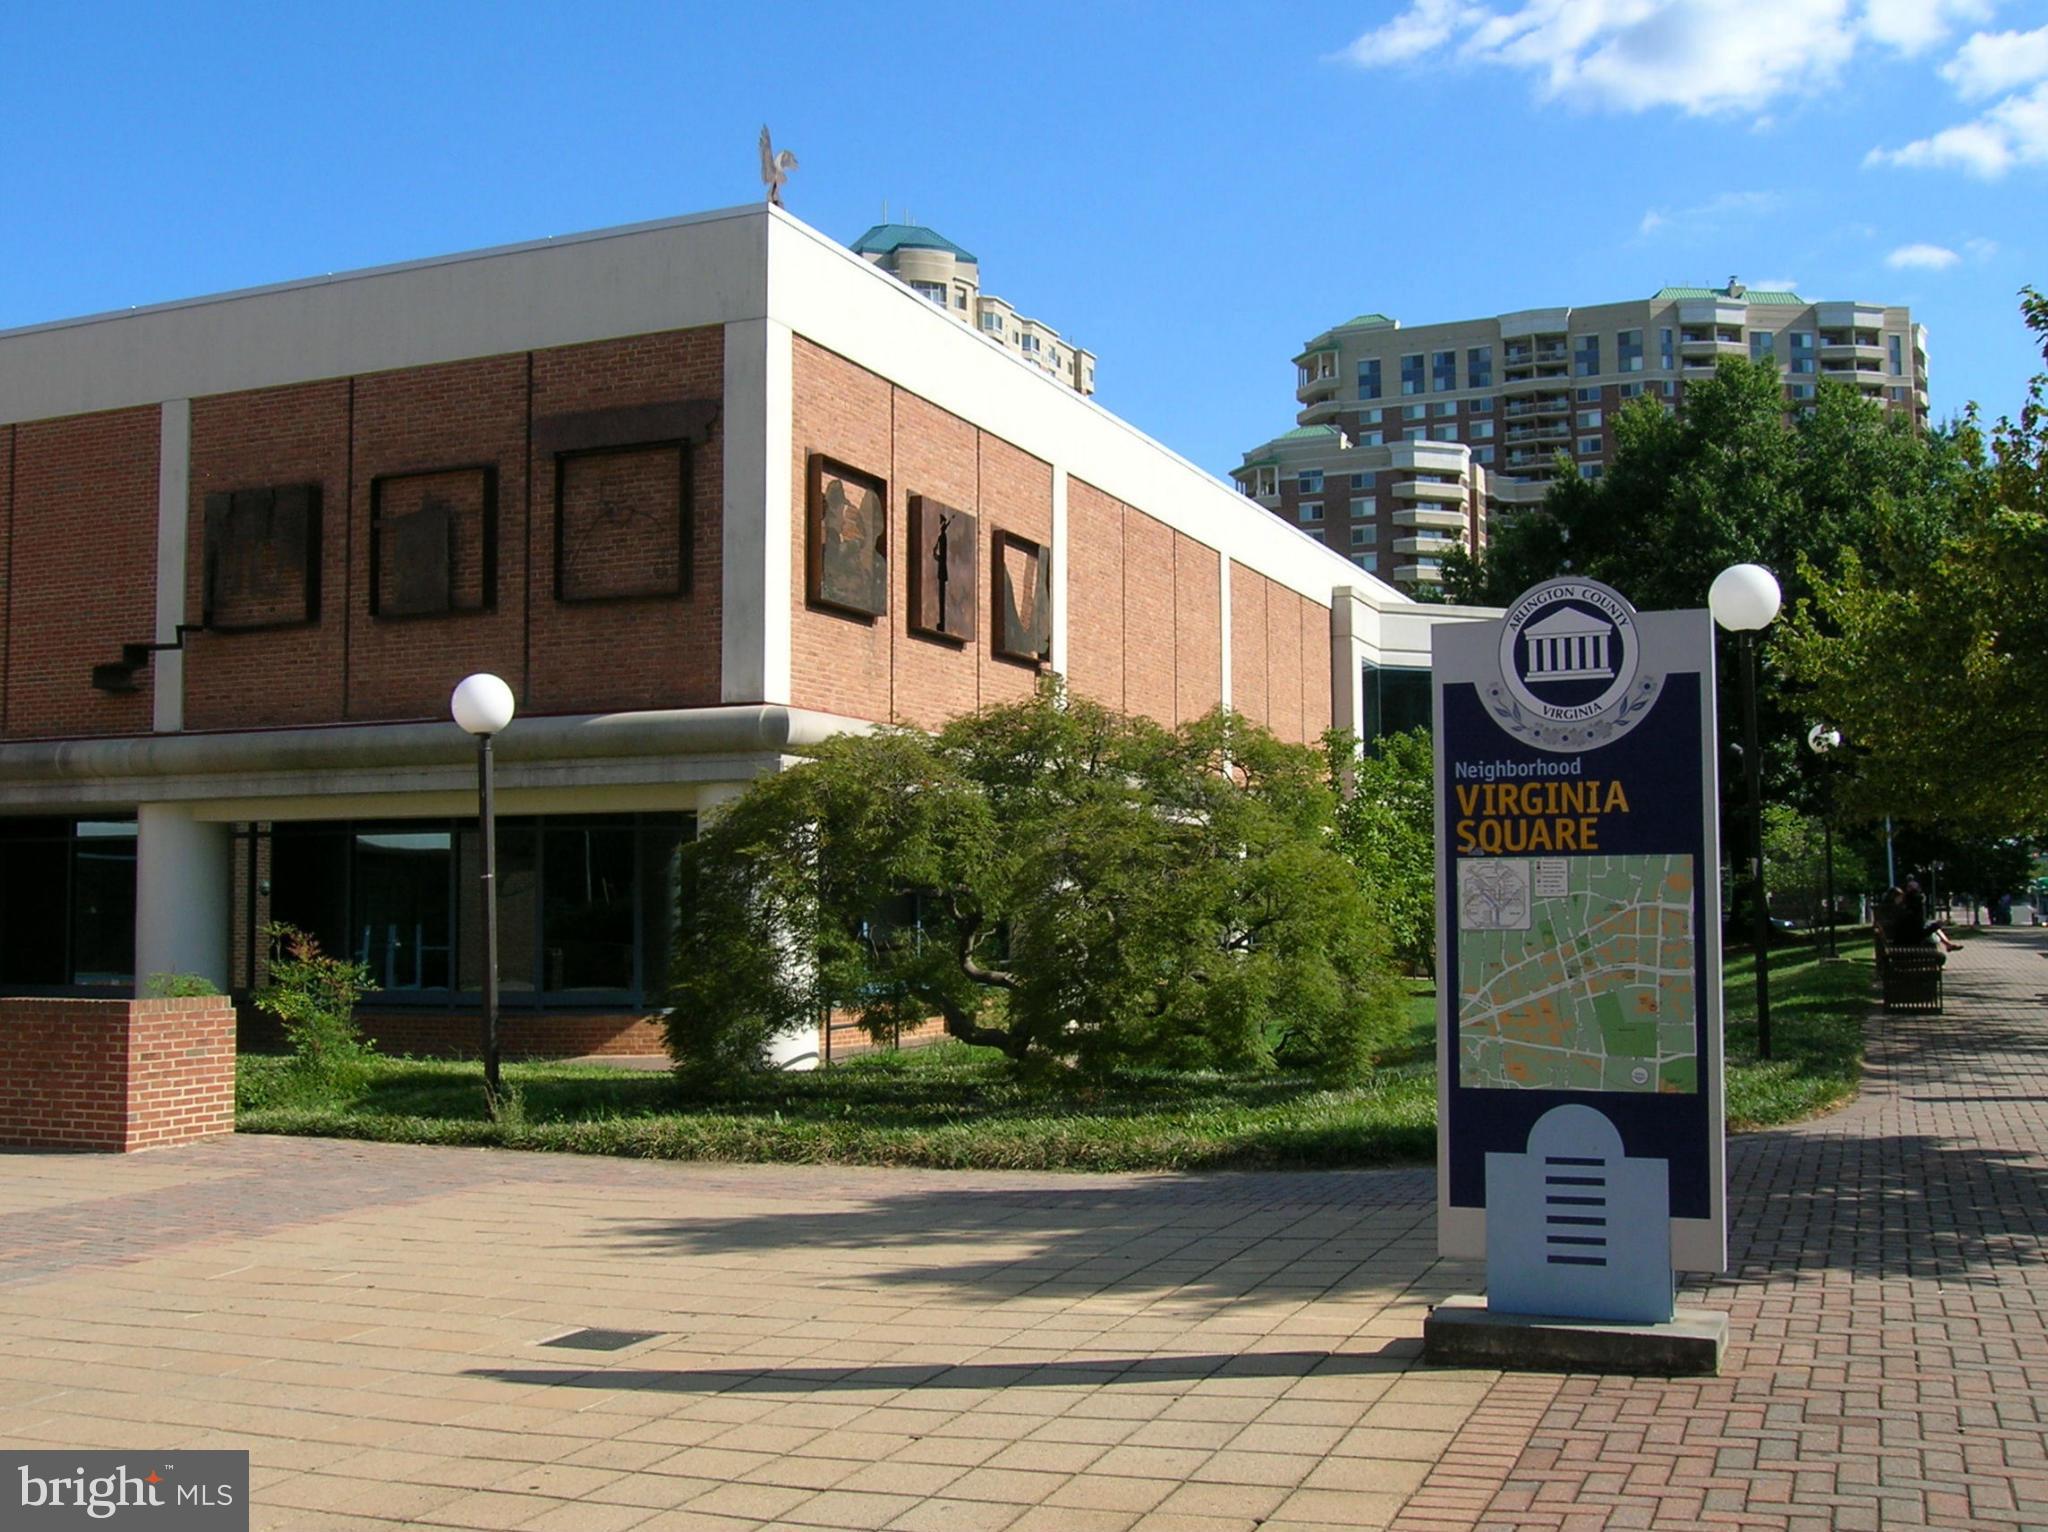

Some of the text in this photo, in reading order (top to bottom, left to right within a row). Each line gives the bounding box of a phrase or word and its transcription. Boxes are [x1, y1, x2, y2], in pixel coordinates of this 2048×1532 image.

[1509, 587, 1630, 632] ARLINGTON COUNTY
[1542, 702, 1603, 719] VIRGINIA
[1455, 757, 1581, 782] Neighborhood
[1456, 780, 1630, 816] VIRGINIA
[1456, 817, 1599, 855] SQUARE
